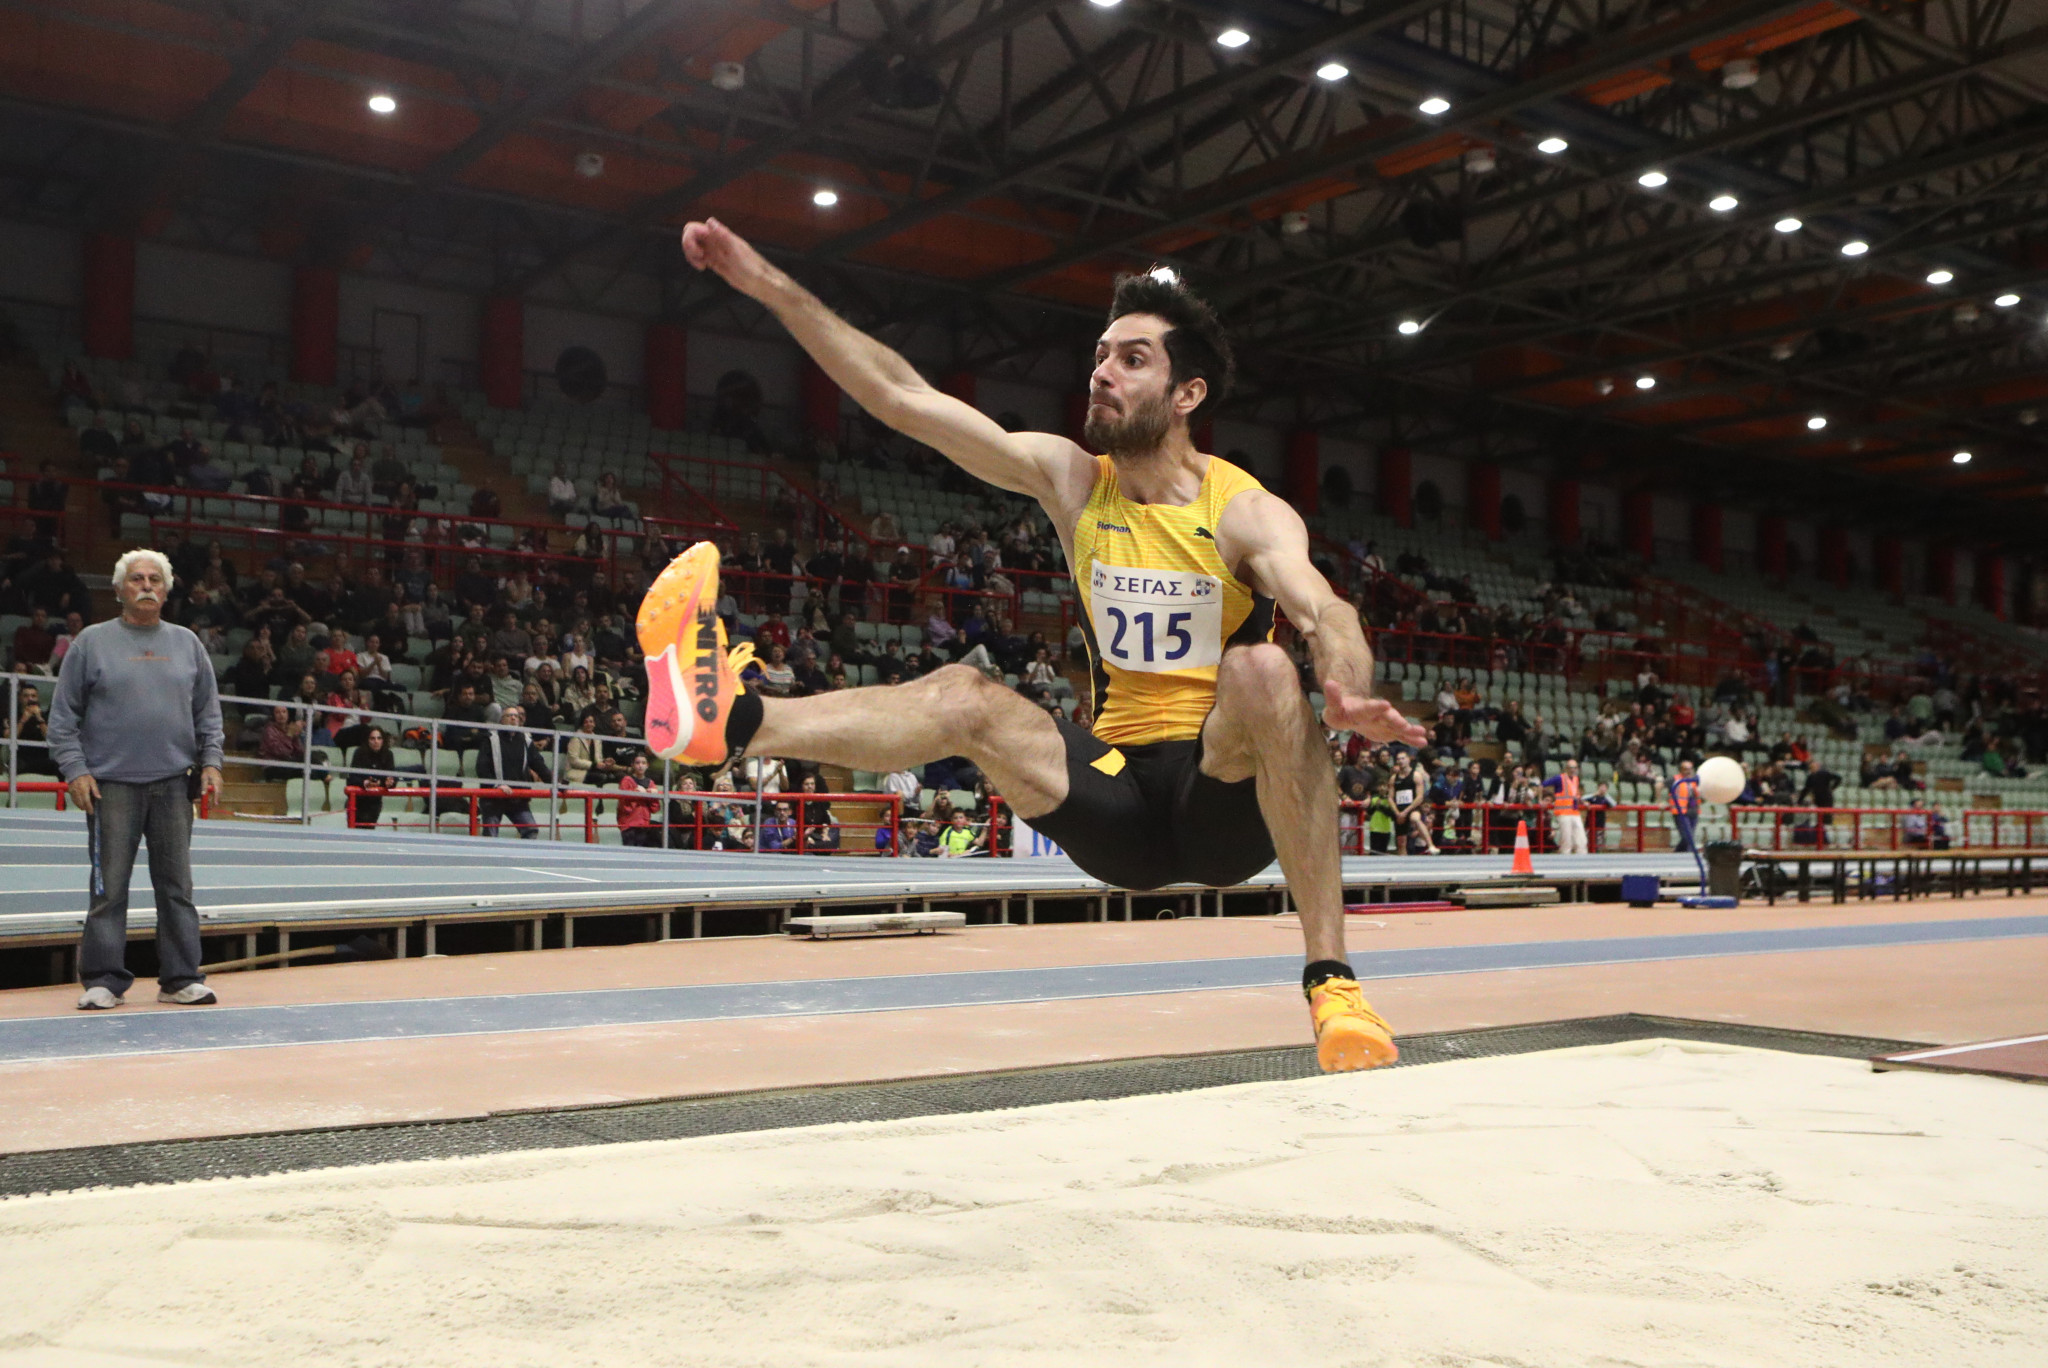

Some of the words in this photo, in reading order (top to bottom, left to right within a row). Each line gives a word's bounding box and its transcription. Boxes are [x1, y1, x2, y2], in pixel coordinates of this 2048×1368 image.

[1113, 575, 1183, 596] ΣΕΓΑΣ
[1106, 607, 1192, 662] 215
[695, 607, 719, 723] NITRO
